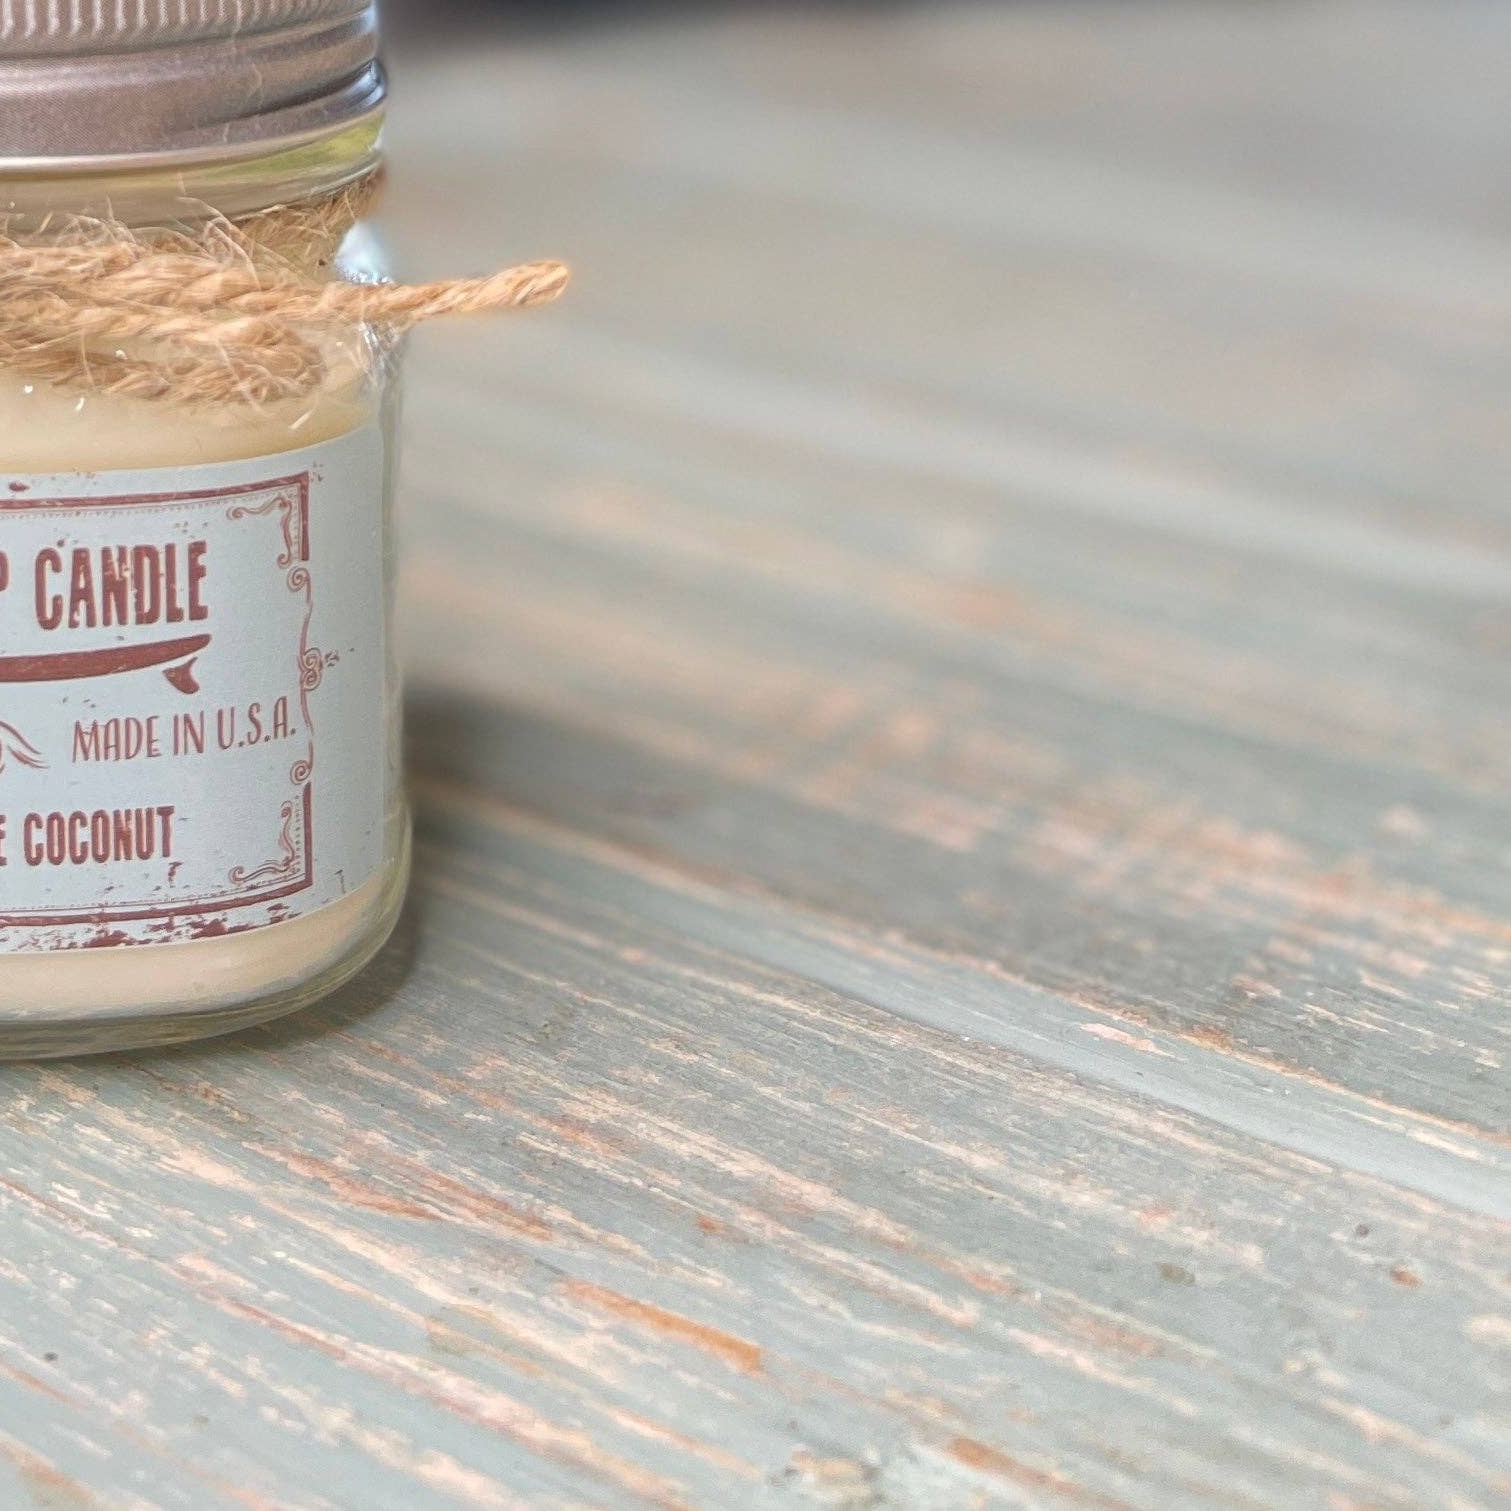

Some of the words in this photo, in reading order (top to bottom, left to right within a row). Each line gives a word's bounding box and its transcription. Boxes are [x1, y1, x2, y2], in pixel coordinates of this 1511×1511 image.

[34, 539, 209, 632] CANDLE
[72, 715, 163, 763] MADE
[173, 710, 205, 756] IN
[216, 695, 297, 751] U.S.A.
[23, 805, 175, 867] COCONUT
